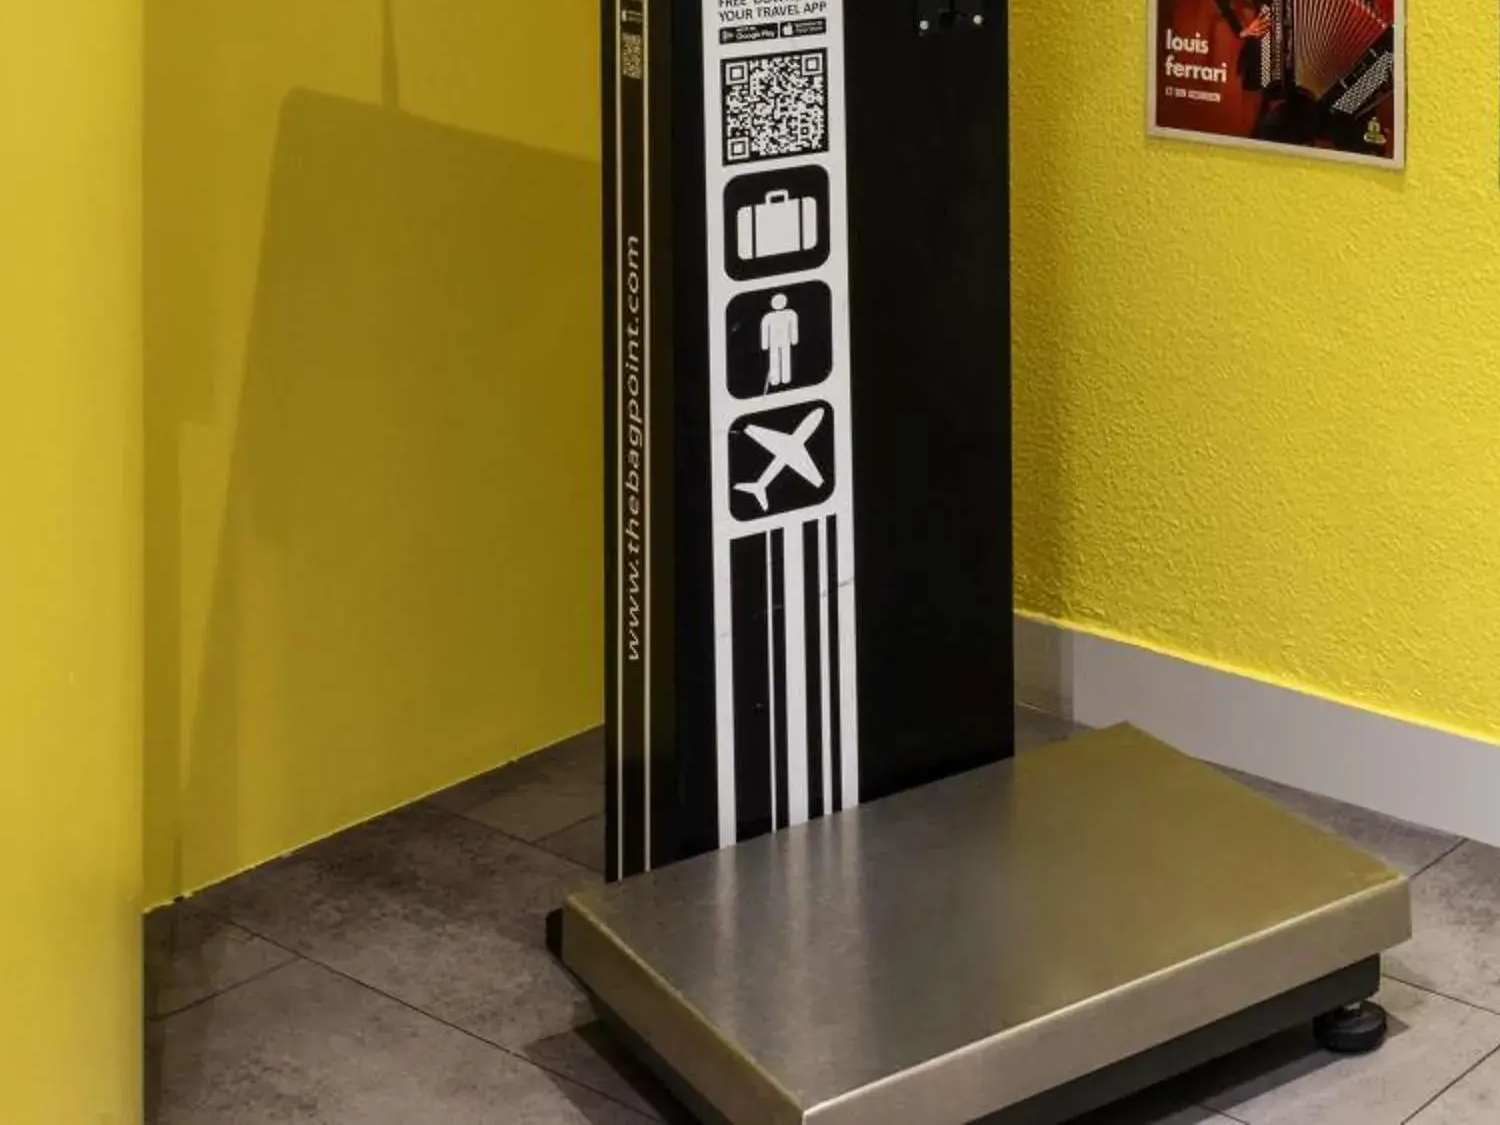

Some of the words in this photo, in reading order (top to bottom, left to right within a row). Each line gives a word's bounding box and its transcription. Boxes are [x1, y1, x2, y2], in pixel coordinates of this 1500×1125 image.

[718, 8, 752, 21] YOUR
[757, 4, 801, 18] TRAVEL
[804, 1, 827, 13] APP
[1166, 28, 1209, 54] louis
[1165, 55, 1227, 83] ferrari
[625, 235, 643, 661] www.thebagpoint.com
